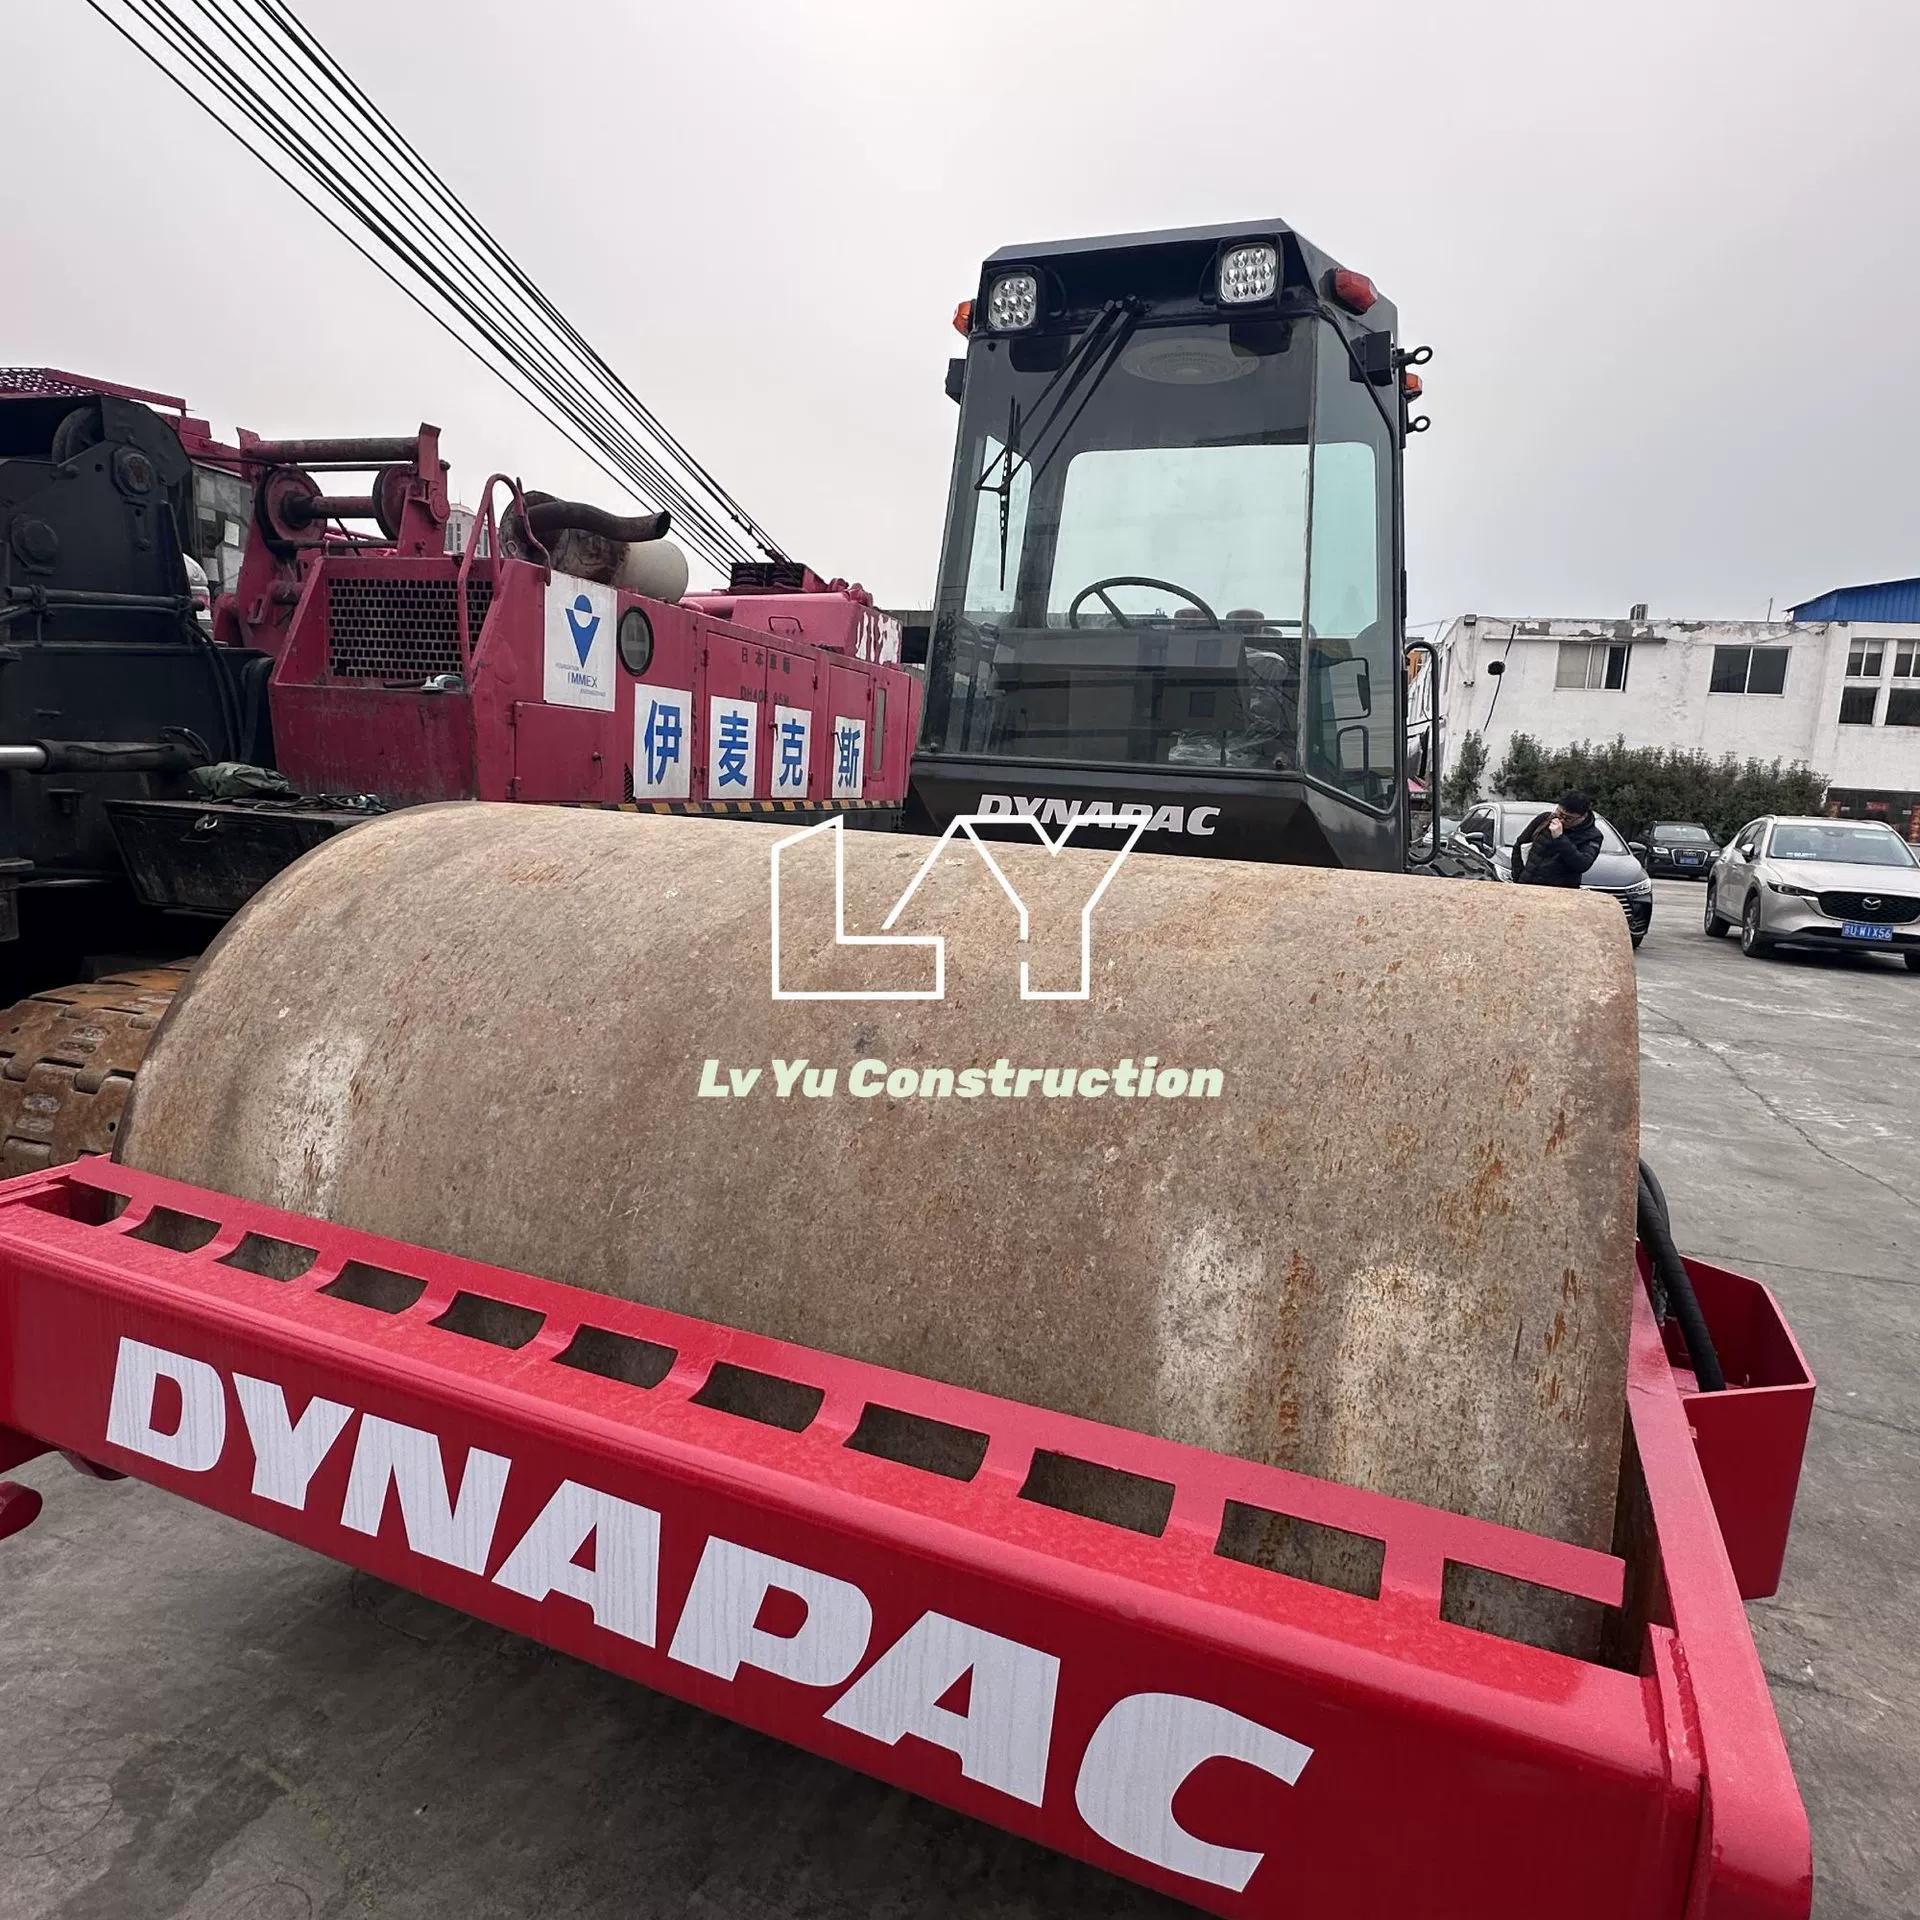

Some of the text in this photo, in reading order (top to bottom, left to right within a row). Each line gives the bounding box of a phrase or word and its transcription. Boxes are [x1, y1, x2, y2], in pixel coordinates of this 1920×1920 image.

[567, 671, 598, 688] IMMEX
[644, 699, 861, 789] 伊麦克斯
[976, 793, 1221, 836] DYNAPAC
[105, 1336, 1314, 1893] DYNAPAC
